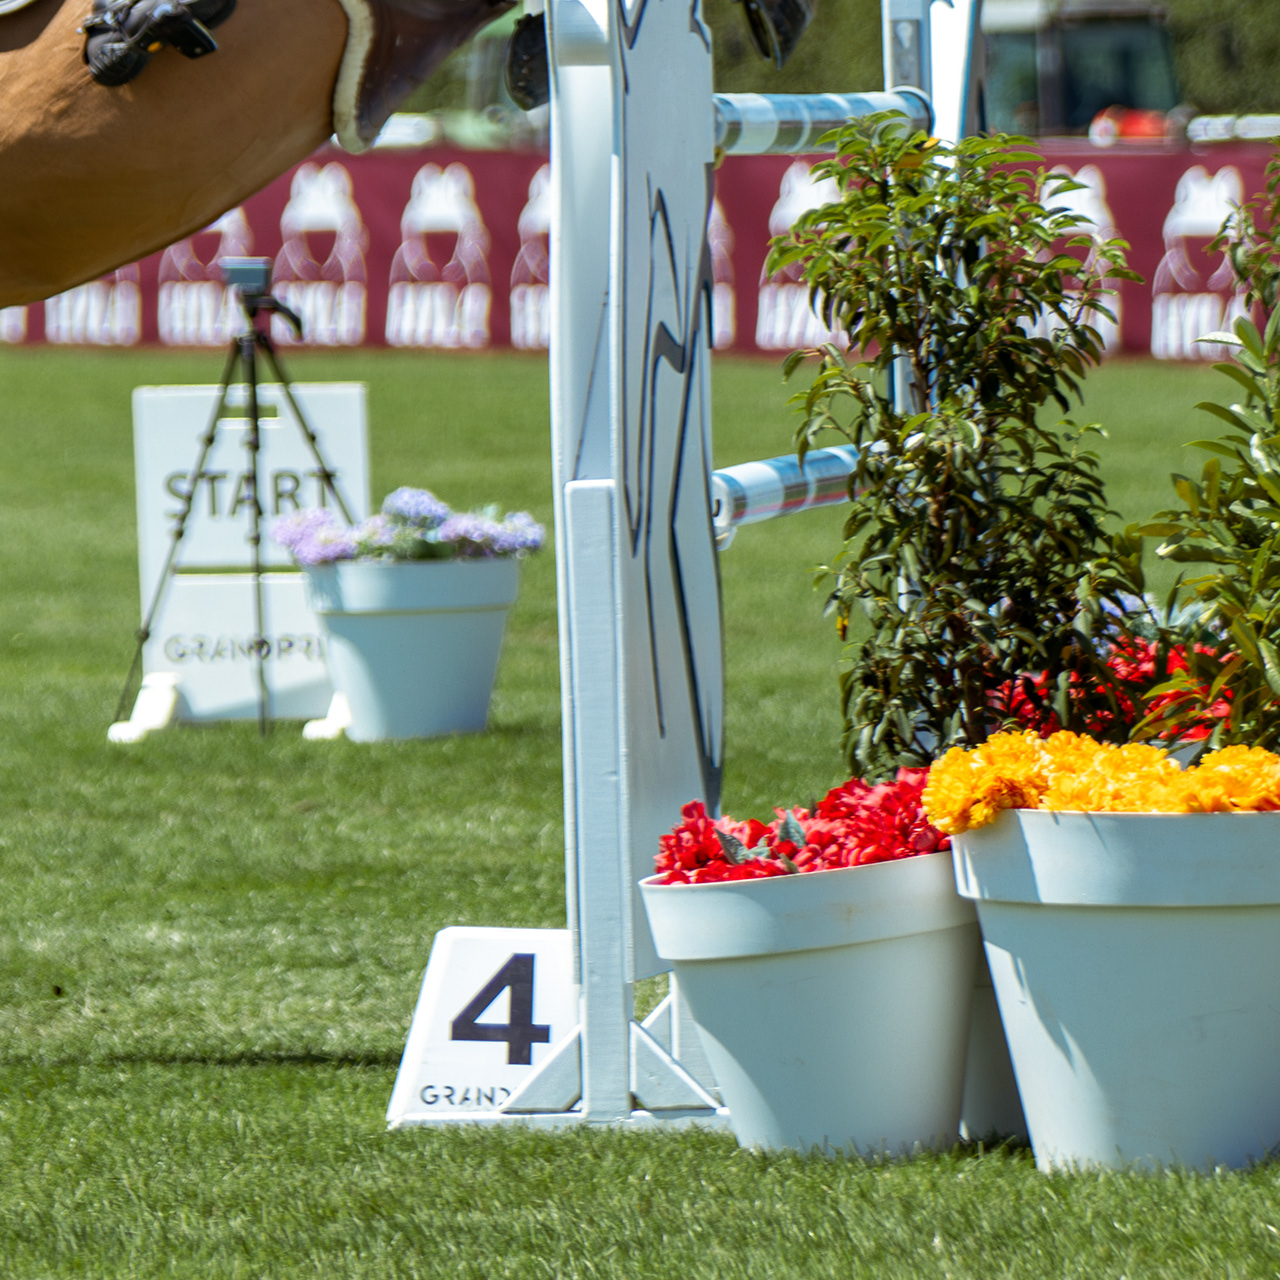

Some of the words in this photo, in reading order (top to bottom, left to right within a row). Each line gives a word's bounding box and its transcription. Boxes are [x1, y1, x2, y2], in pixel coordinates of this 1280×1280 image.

[164, 469, 339, 519] START
[164, 633, 327, 663] GRANDPRI
[448, 951, 551, 1066] 4
[419, 1084, 516, 1106] GRAND
